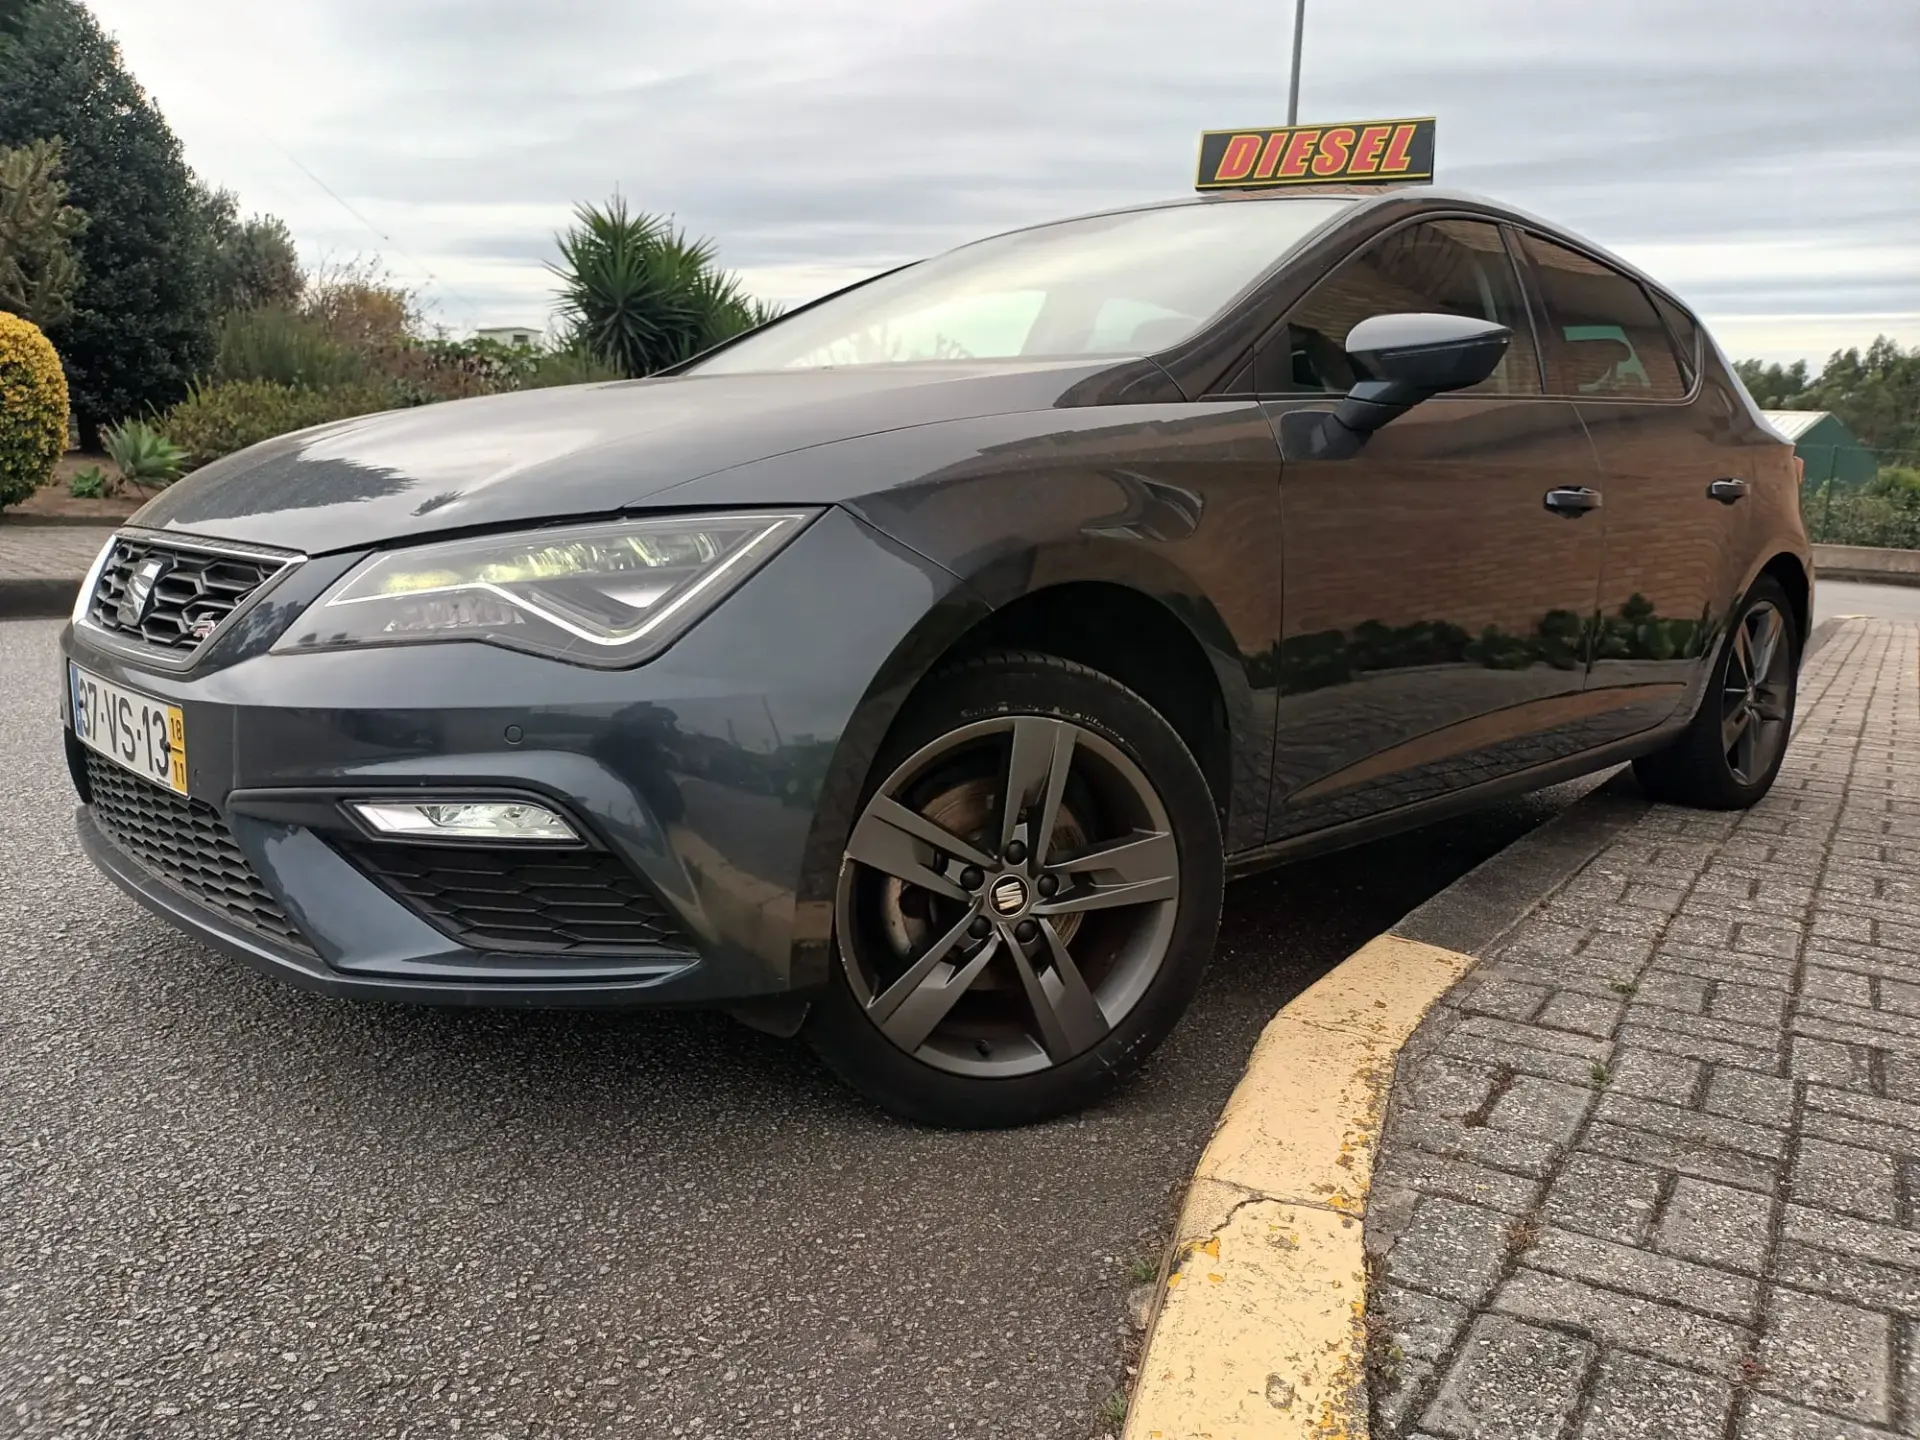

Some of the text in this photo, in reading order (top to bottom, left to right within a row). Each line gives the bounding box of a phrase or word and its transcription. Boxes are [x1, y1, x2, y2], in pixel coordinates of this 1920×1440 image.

[1214, 124, 1417, 181] DIESEL
[170, 717, 182, 741] 18
[173, 760, 185, 785] 11
